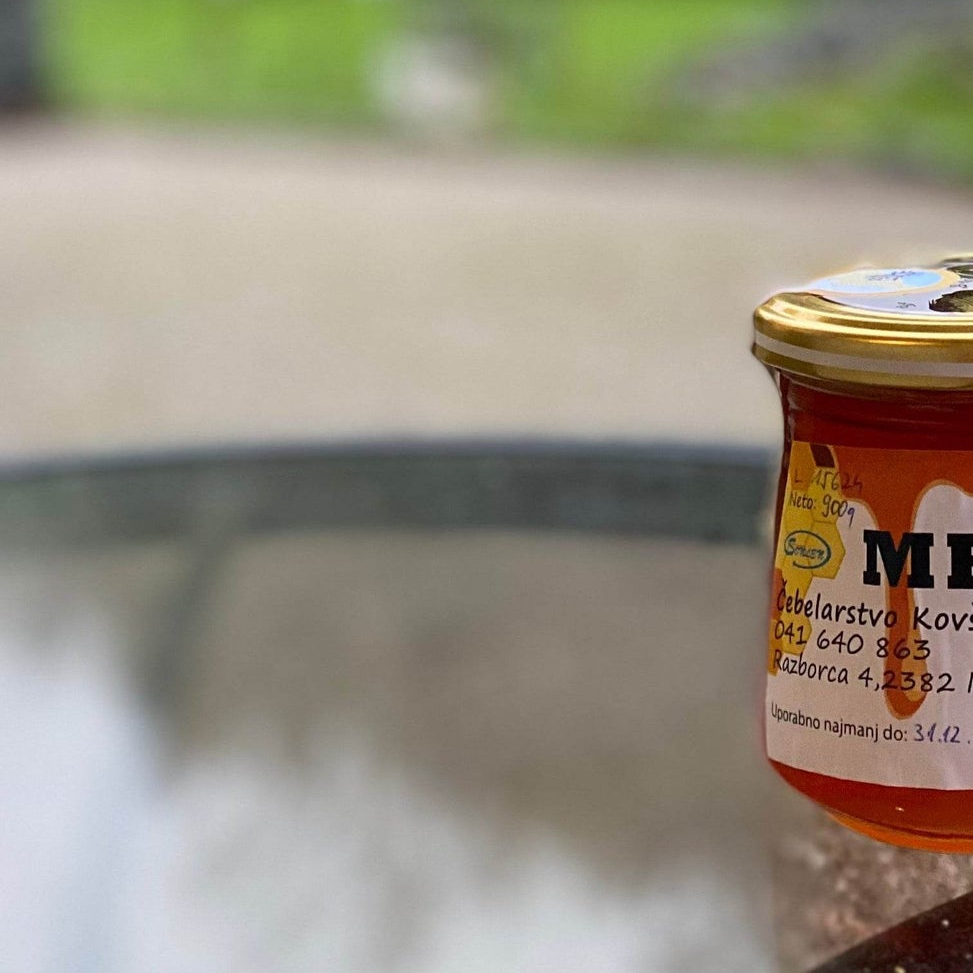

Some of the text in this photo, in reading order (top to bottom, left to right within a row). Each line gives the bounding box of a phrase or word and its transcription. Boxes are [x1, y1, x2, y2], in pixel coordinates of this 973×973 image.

[776, 579, 898, 628] Čebelarstvo
[774, 619, 931, 661] 041 640 863
[773, 649, 849, 685] Razborca
[770, 701, 821, 730] Uporabno
[823, 719, 879, 743] najmanj
[882, 726, 908, 742] do:
